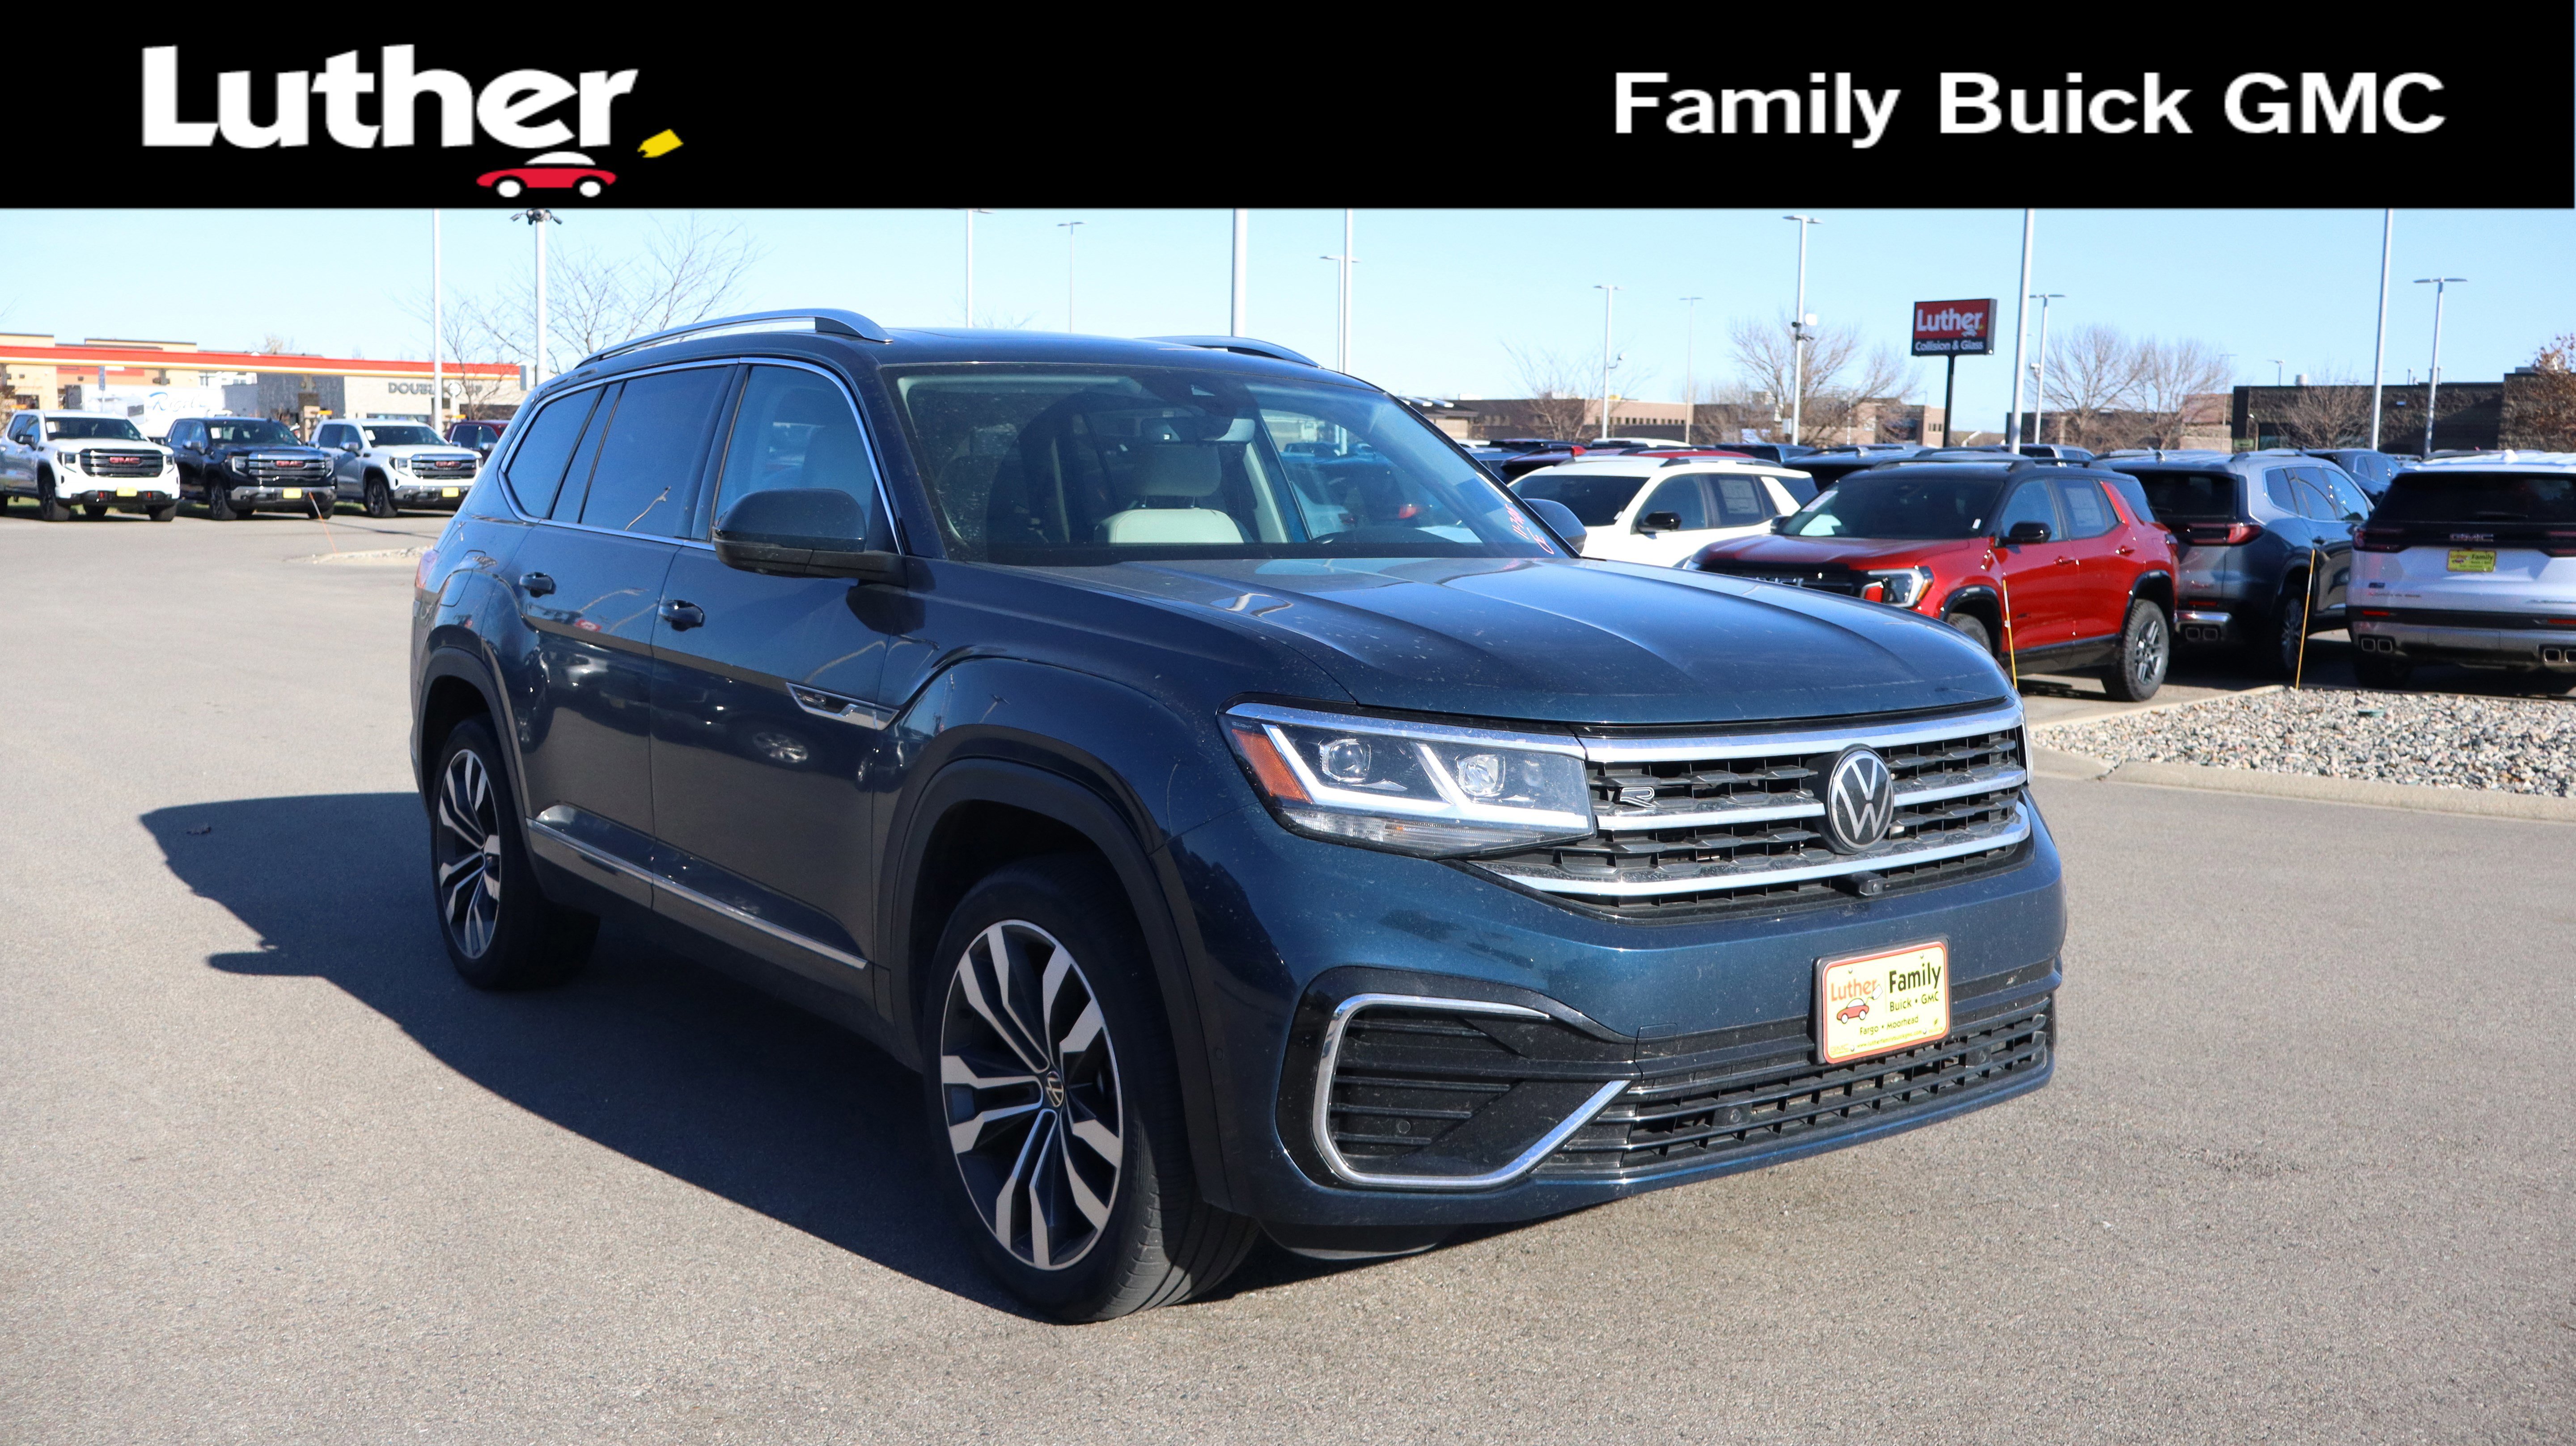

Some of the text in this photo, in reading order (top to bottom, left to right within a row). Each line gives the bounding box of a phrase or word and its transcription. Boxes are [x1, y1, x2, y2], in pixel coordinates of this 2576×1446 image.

[1916, 308, 1983, 331] Luther
[1915, 339, 1984, 352] Collision & Glass
[388, 382, 436, 394] DOUBL
[1889, 962, 1941, 993] Family
[1831, 978, 1877, 1001] Luther
[1890, 991, 1939, 1012] Buick GMC
[1860, 1015, 1919, 1035] Fargo Moorhead
